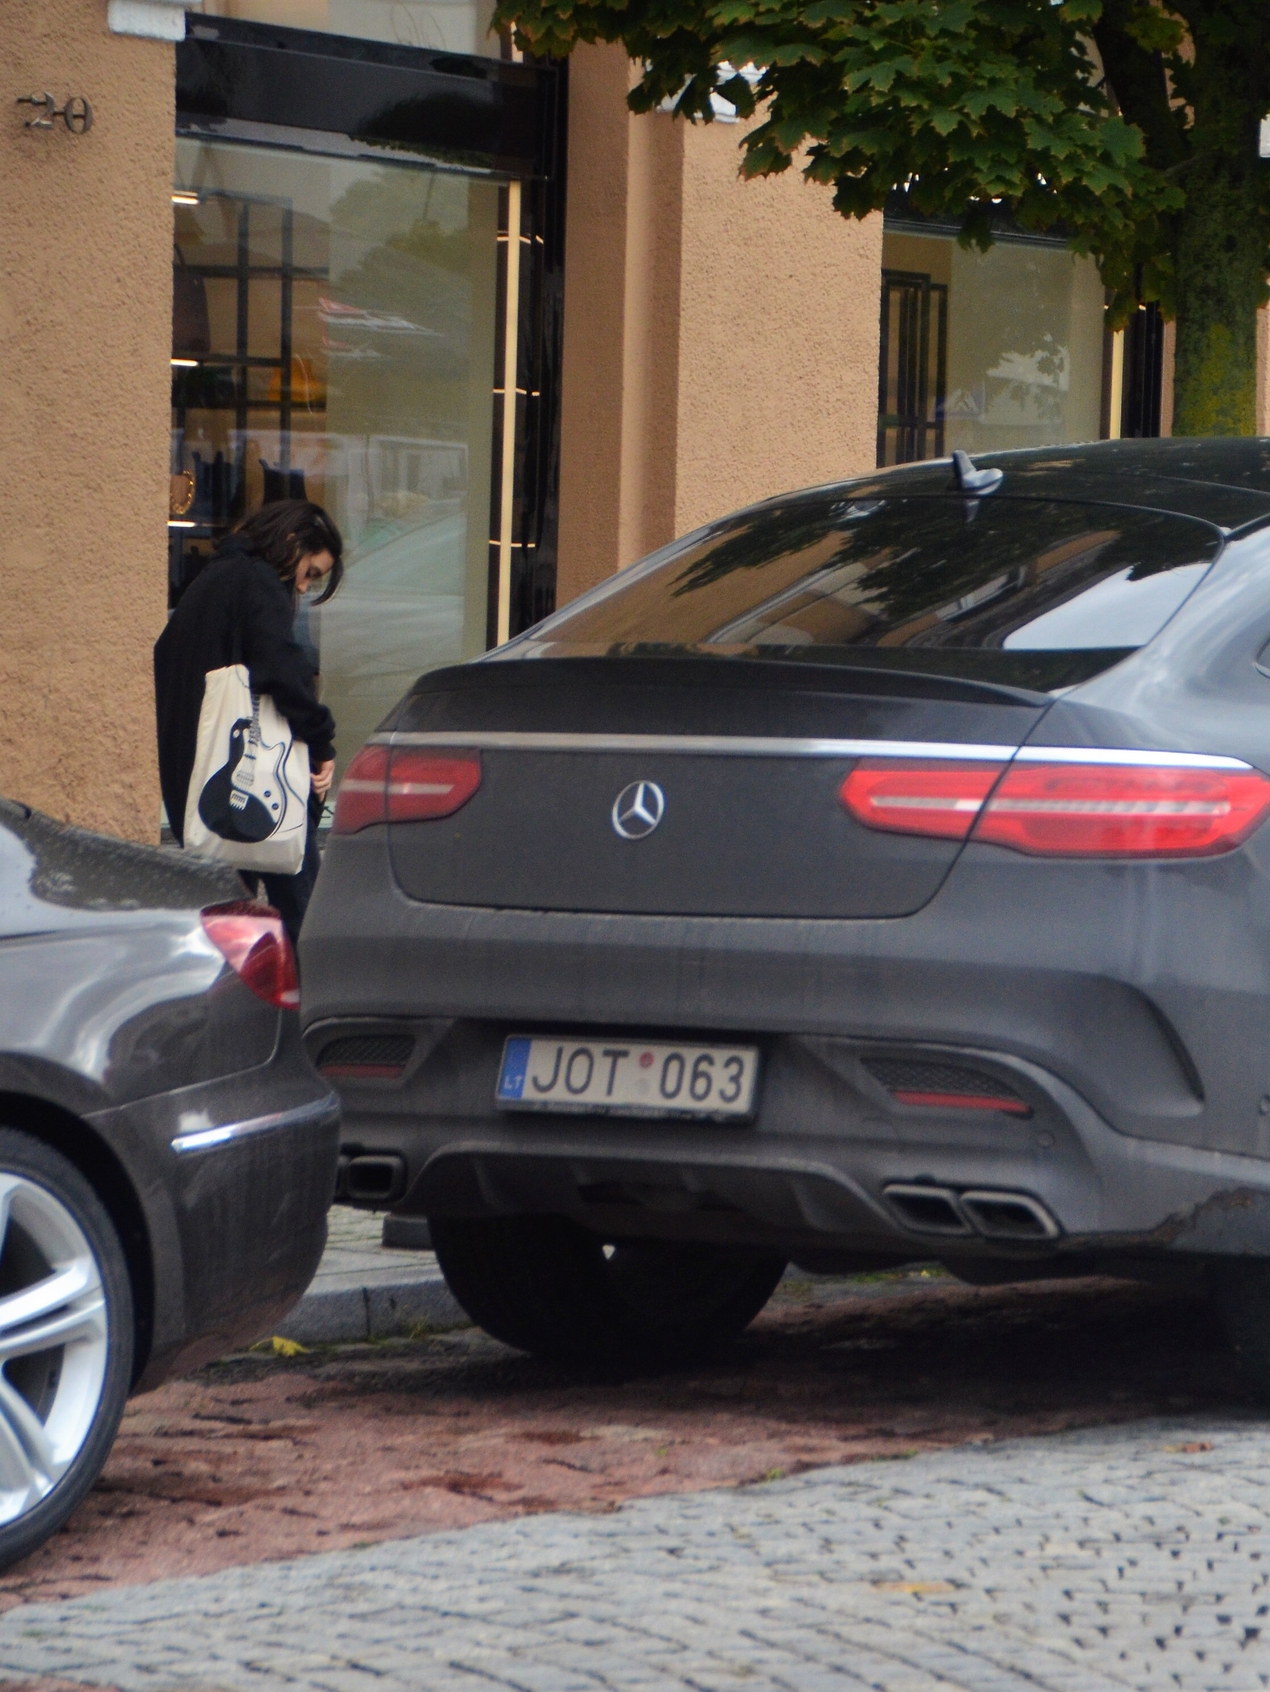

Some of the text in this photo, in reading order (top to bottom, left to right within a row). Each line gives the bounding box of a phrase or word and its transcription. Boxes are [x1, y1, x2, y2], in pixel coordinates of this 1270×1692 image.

[27, 91, 94, 135] 20
[532, 1046, 630, 1097] JOT
[659, 1052, 745, 1103] 063
